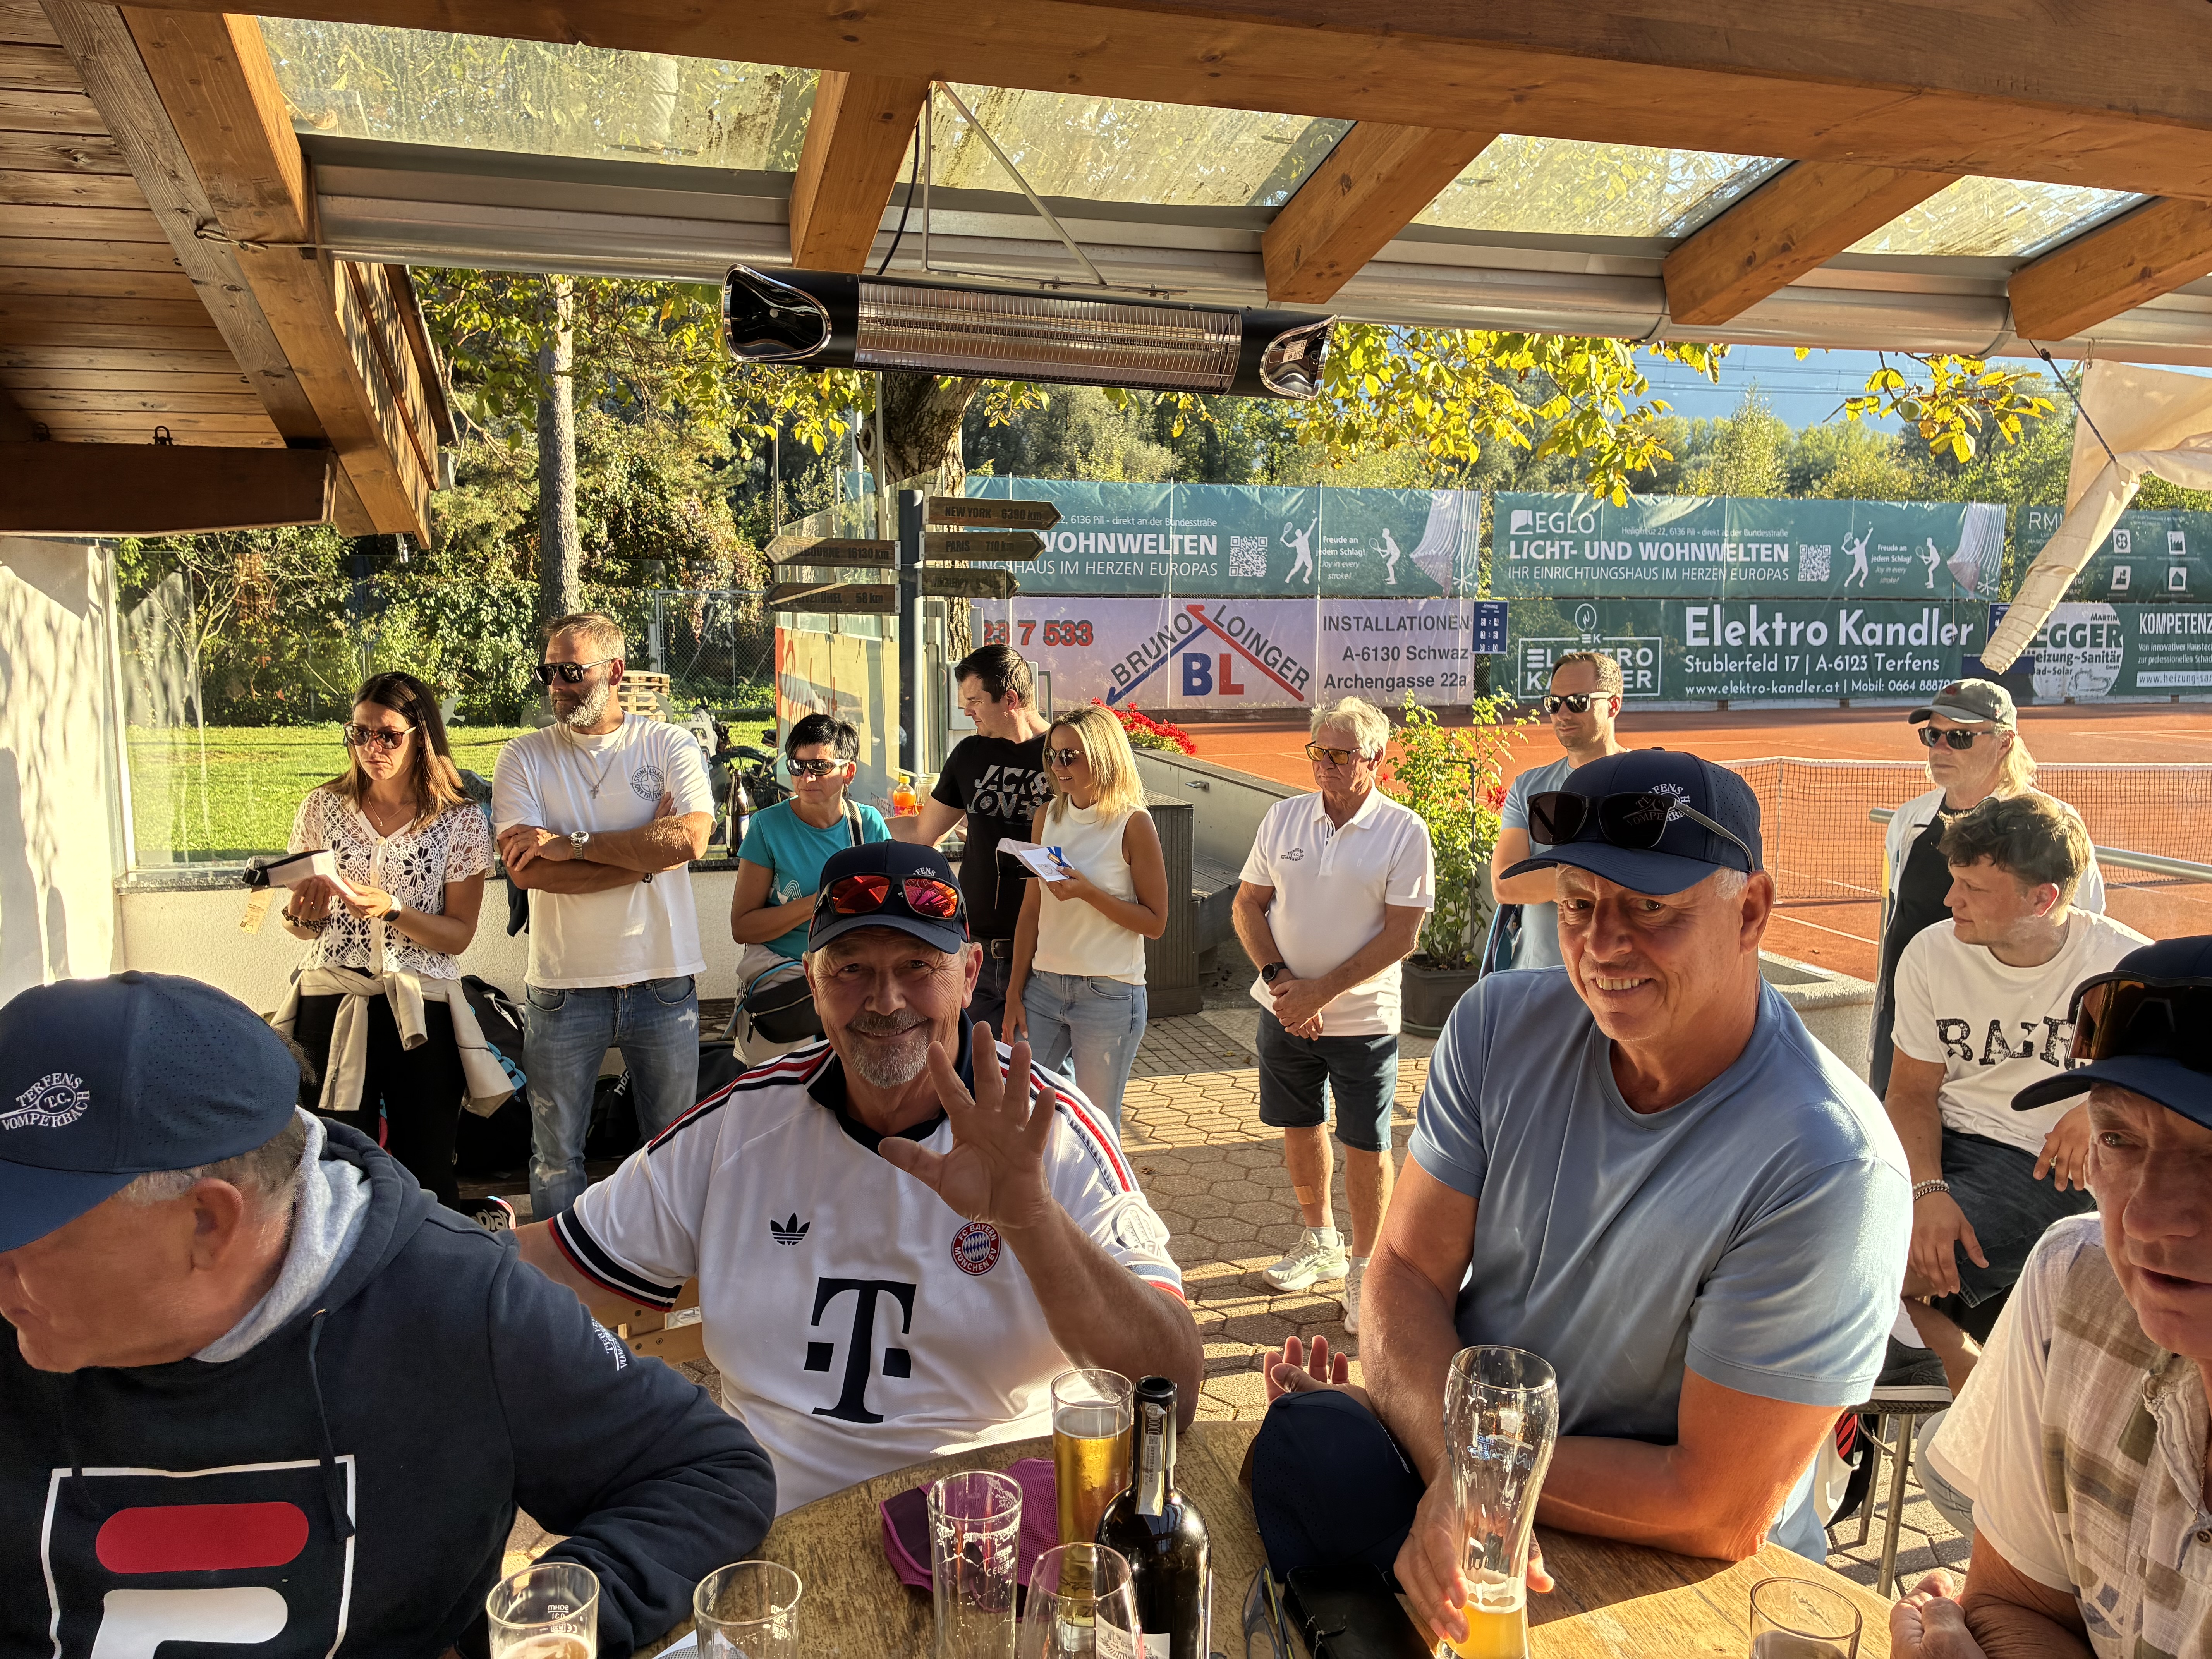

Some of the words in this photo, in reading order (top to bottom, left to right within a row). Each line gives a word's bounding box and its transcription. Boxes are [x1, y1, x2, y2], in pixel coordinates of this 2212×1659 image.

[945, 506, 965, 517] NEW
[968, 508, 991, 518] YORK
[1001, 508, 1025, 520] 6390
[1028, 510, 1042, 520] km
[1071, 515, 1091, 524] 6136
[1093, 515, 1104, 524] Pill
[1113, 516, 1135, 525] direkt
[1150, 517, 1163, 526] der
[1535, 511, 1595, 534] EGLO
[1669, 528, 1685, 536] 6136
[1702, 527, 1720, 536] direkt
[1730, 529, 1741, 537] der
[848, 547, 873, 558] 16130
[875, 549, 889, 560] km
[946, 540, 970, 552] PARIS
[1340, 548, 1365, 557] Schlag!
[1510, 540, 1577, 560] LICHT-
[1585, 541, 1632, 561] UND
[1638, 542, 1788, 562] WOHNWELTEN
[1878, 543, 1898, 551] Freude
[1061, 561, 1079, 574] IM
[1086, 561, 1143, 575] HERZEN
[1150, 562, 1218, 577] EUROPAS
[1508, 566, 1529, 579] IHR
[1534, 566, 1658, 580] EINRICHTUNGSHAUS
[1662, 568, 1676, 580] IM
[1682, 567, 1726, 581] HERZEN
[1730, 568, 1789, 581] EUROPAS
[856, 593, 867, 603] 58
[869, 593, 884, 603] km
[1324, 615, 1469, 631] INSTALLATIONEN
[1686, 604, 1828, 646] Elektro
[1839, 608, 1973, 647] Kandler
[1018, 620, 1036, 646] 7
[1043, 620, 1094, 646] 533
[1111, 613, 1193, 686] BRUNO
[1213, 604, 1310, 690] LOINGER
[1342, 646, 1400, 661] A-6130
[1406, 645, 1468, 660] Schwaz
[2138, 643, 2149, 651] Von
[2151, 642, 2185, 651] innovativer
[2187, 642, 2212, 651] Haustec
[1685, 653, 1778, 673] Stublerfeld
[1784, 655, 1798, 672] 17
[1815, 654, 1868, 672] A-6123
[1874, 653, 1939, 672] Terfens
[2138, 656, 2147, 664] zur
[2148, 653, 2193, 666] professionellen
[1324, 674, 1434, 692] Archengasse
[1441, 673, 1467, 687] 22a
[1685, 680, 1840, 695] www.elektro-kandler.at
[1851, 679, 1884, 692] Mobil:
[1888, 680, 1915, 691] 0664
[634, 768, 647, 781] STONE
[634, 783, 652, 799] ISLAND
[15, 1073, 83, 1107] TERFENS
[44, 1093, 71, 1108] T.C.
[2, 1090, 90, 1130] VOMPERBACH
[958, 1230, 968, 1240] FC
[970, 1224, 997, 1241] BAYERN
[955, 1247, 989, 1271] MÜNCHEN
[988, 1247, 996, 1260] EV
